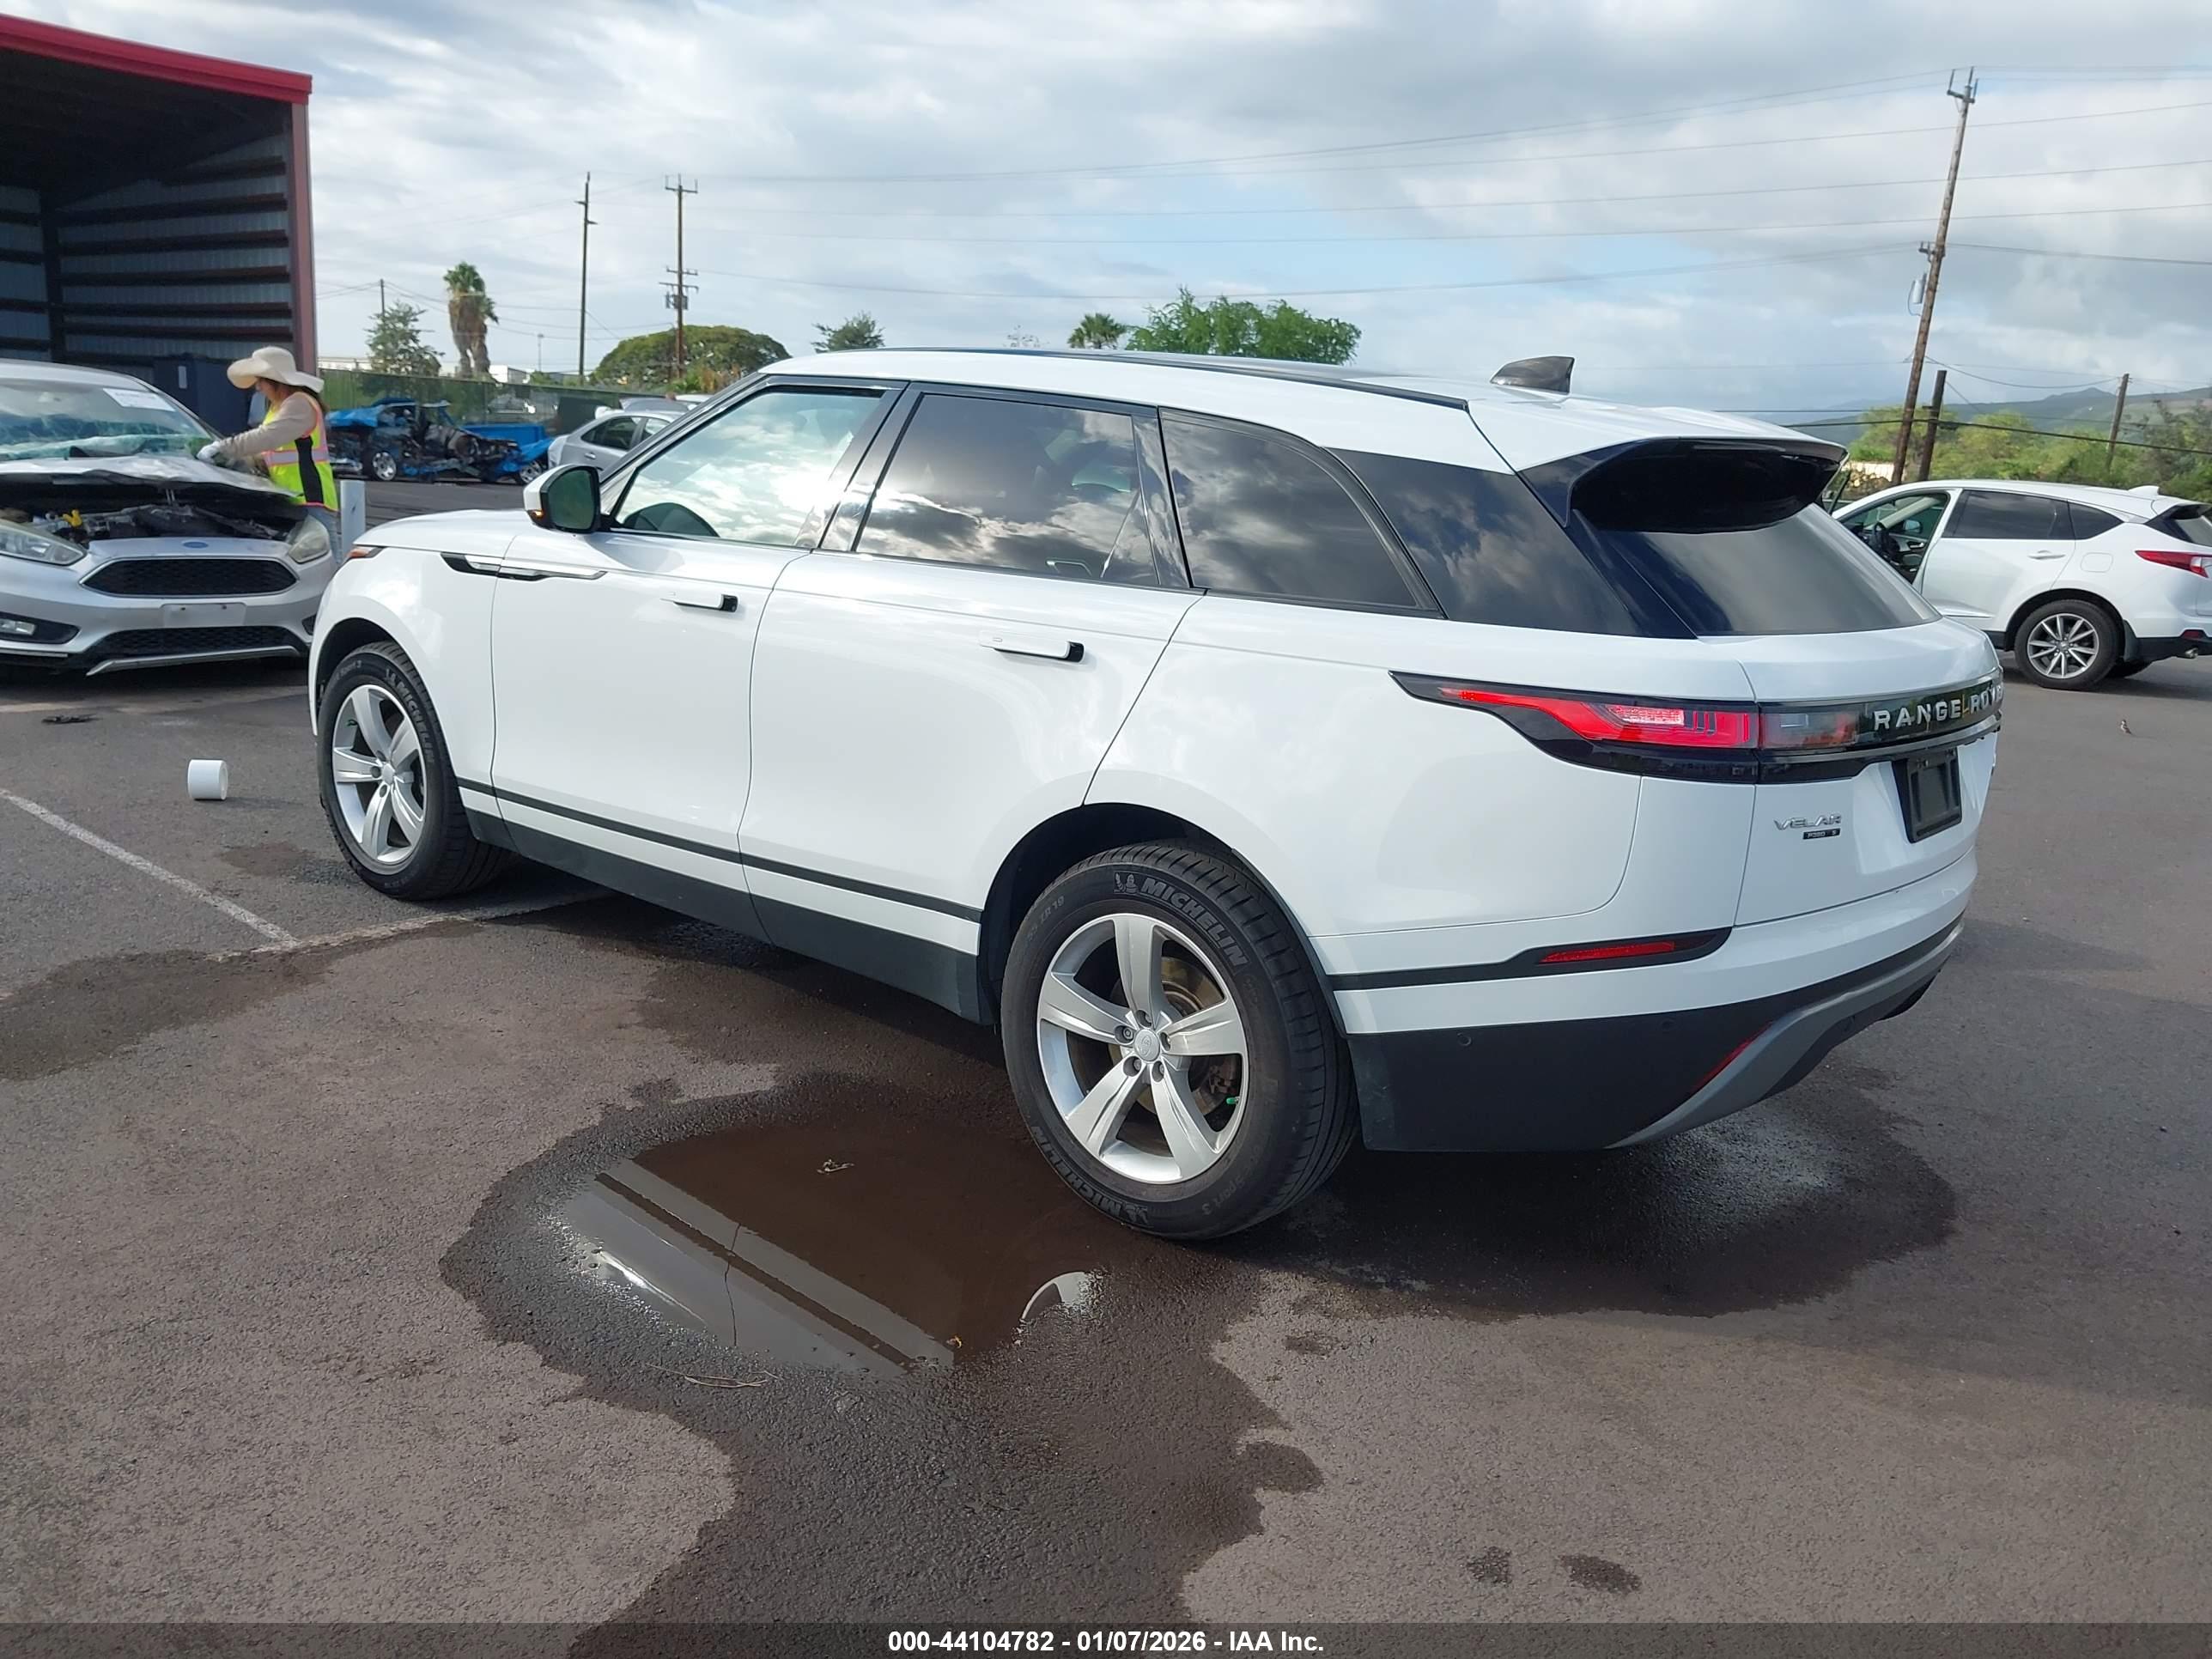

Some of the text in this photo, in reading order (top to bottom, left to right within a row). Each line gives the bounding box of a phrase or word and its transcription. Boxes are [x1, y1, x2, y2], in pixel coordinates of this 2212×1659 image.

[397, 681, 435, 763] MICHELIN
[1874, 699, 1961, 731] RANGE
[1140, 877, 1249, 967] MICHELIN
[1030, 1126, 1121, 1218] MICHELIN
